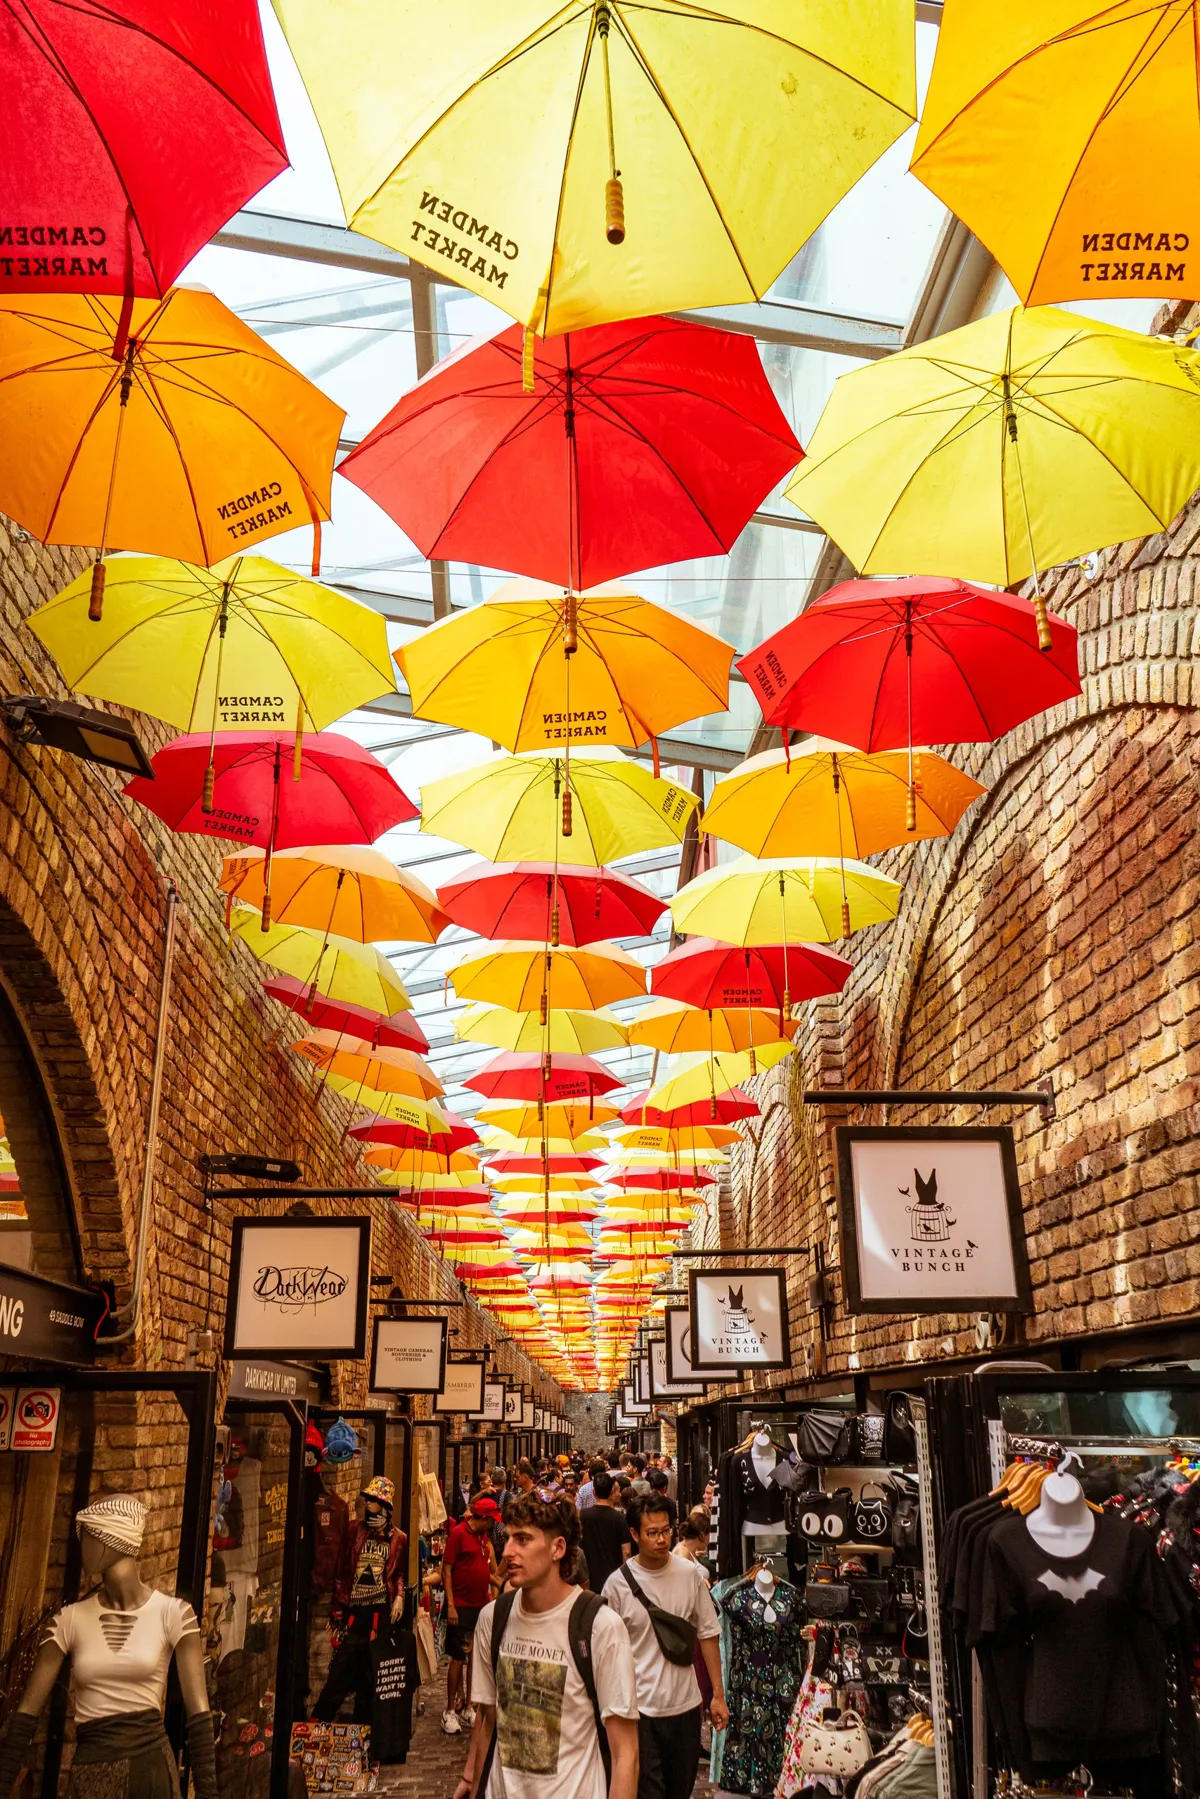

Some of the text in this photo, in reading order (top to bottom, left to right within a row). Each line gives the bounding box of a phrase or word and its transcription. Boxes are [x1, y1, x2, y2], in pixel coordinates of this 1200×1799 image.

[891, 1248, 974, 1258] VINTAGE
[902, 1262, 965, 1272] BUNCH
[56, 1311, 73, 1326] SADDLE
[245, 1366, 296, 1395] DARKWEAR UK LIMITED
[500, 1641, 566, 1661] LAUDE MONET
[380, 1657, 404, 1668] SORRY
[375, 1683, 396, 1693] WANT
